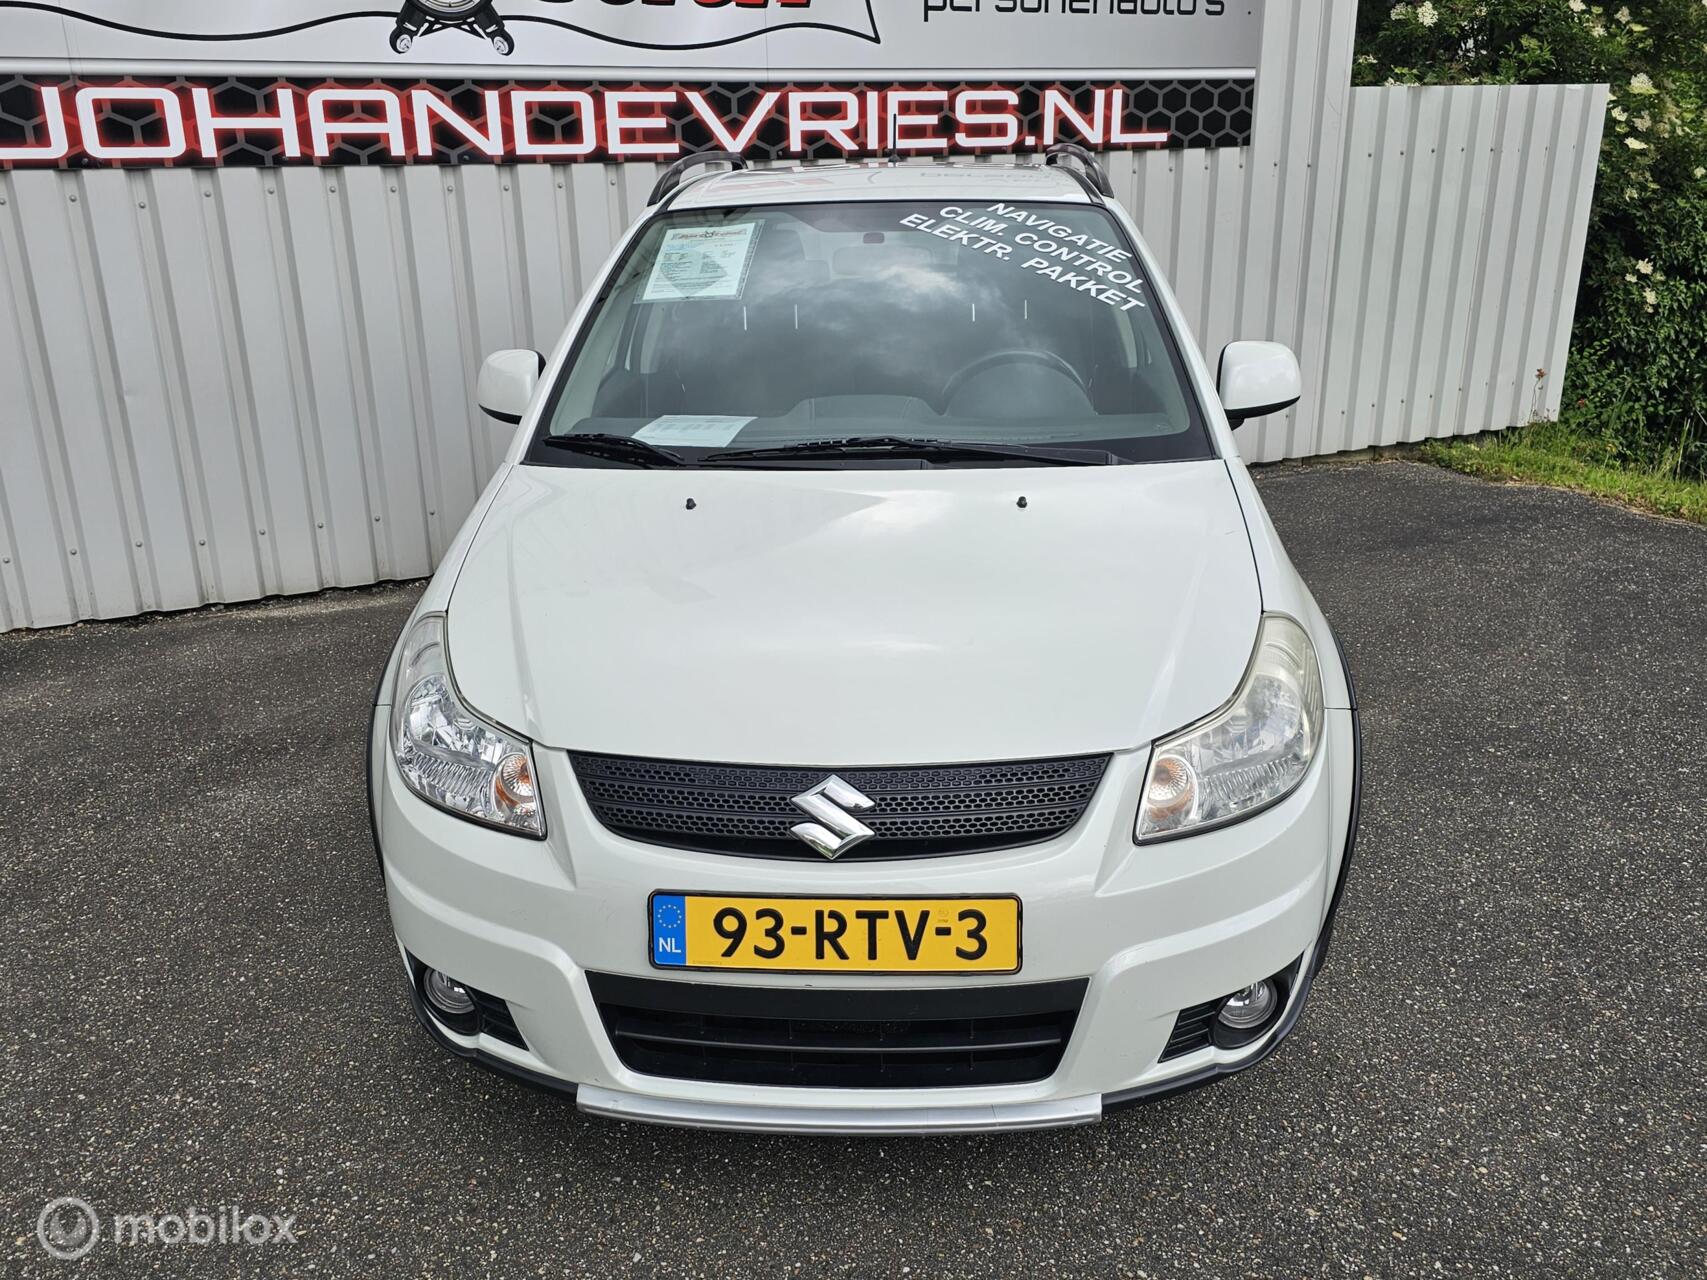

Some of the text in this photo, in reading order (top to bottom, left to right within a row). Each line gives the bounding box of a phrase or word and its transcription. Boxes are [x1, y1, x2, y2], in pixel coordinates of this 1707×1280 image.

[923, 0, 1225, 23] personenautos
[0, 86, 1168, 159] JOHANDEVRIES.NL
[899, 213, 1146, 312] ELEKTR. PAKKET
[939, 206, 1145, 294] CLIM. CONTROL
[986, 202, 1133, 263] NAVIGATIE
[658, 936, 682, 953] NL
[713, 906, 988, 961] 93-RTV-3
